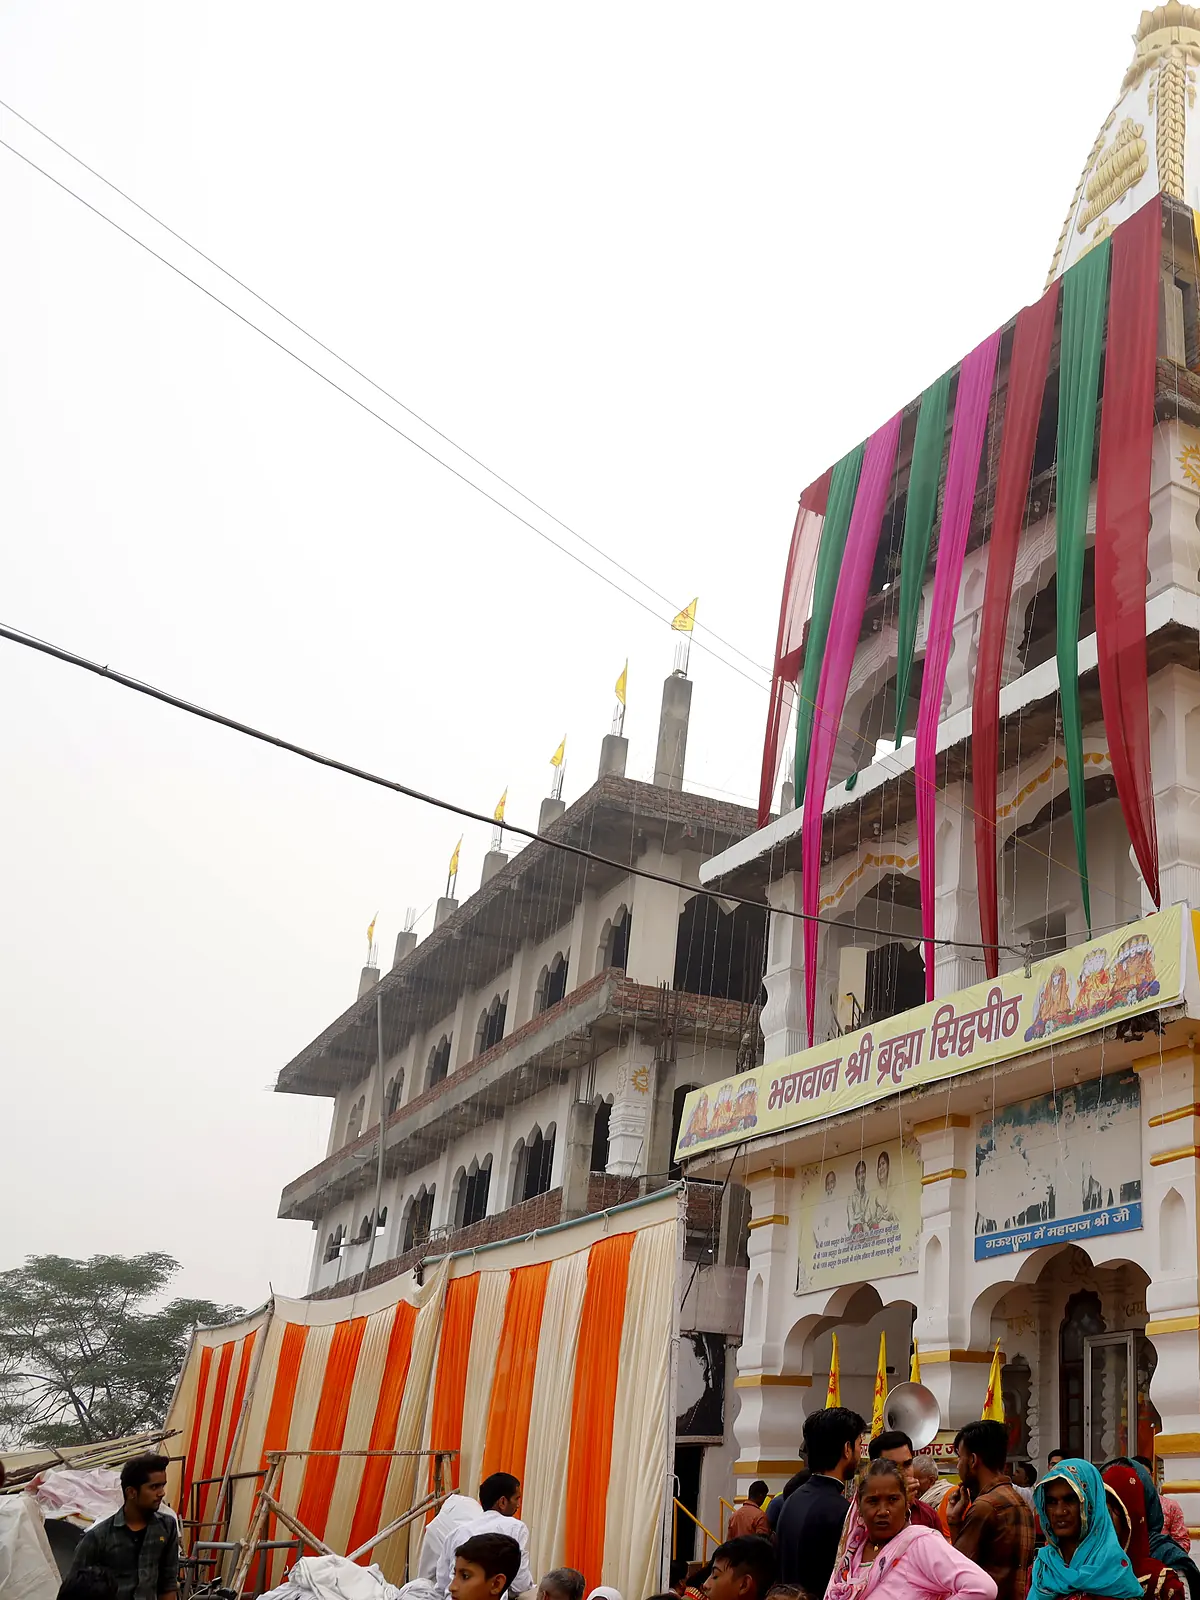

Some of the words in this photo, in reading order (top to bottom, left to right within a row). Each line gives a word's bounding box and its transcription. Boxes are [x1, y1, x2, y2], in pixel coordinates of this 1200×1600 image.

[768, 1058, 842, 1110] भगवान
[845, 1033, 874, 1086] श्री
[877, 1028, 926, 1085] ब्रह्मा
[1034, 1226, 1047, 1239] में
[1047, 1220, 1091, 1237] महाराज
[1094, 1213, 1109, 1227] श्री
[1112, 1208, 1130, 1222] जी
